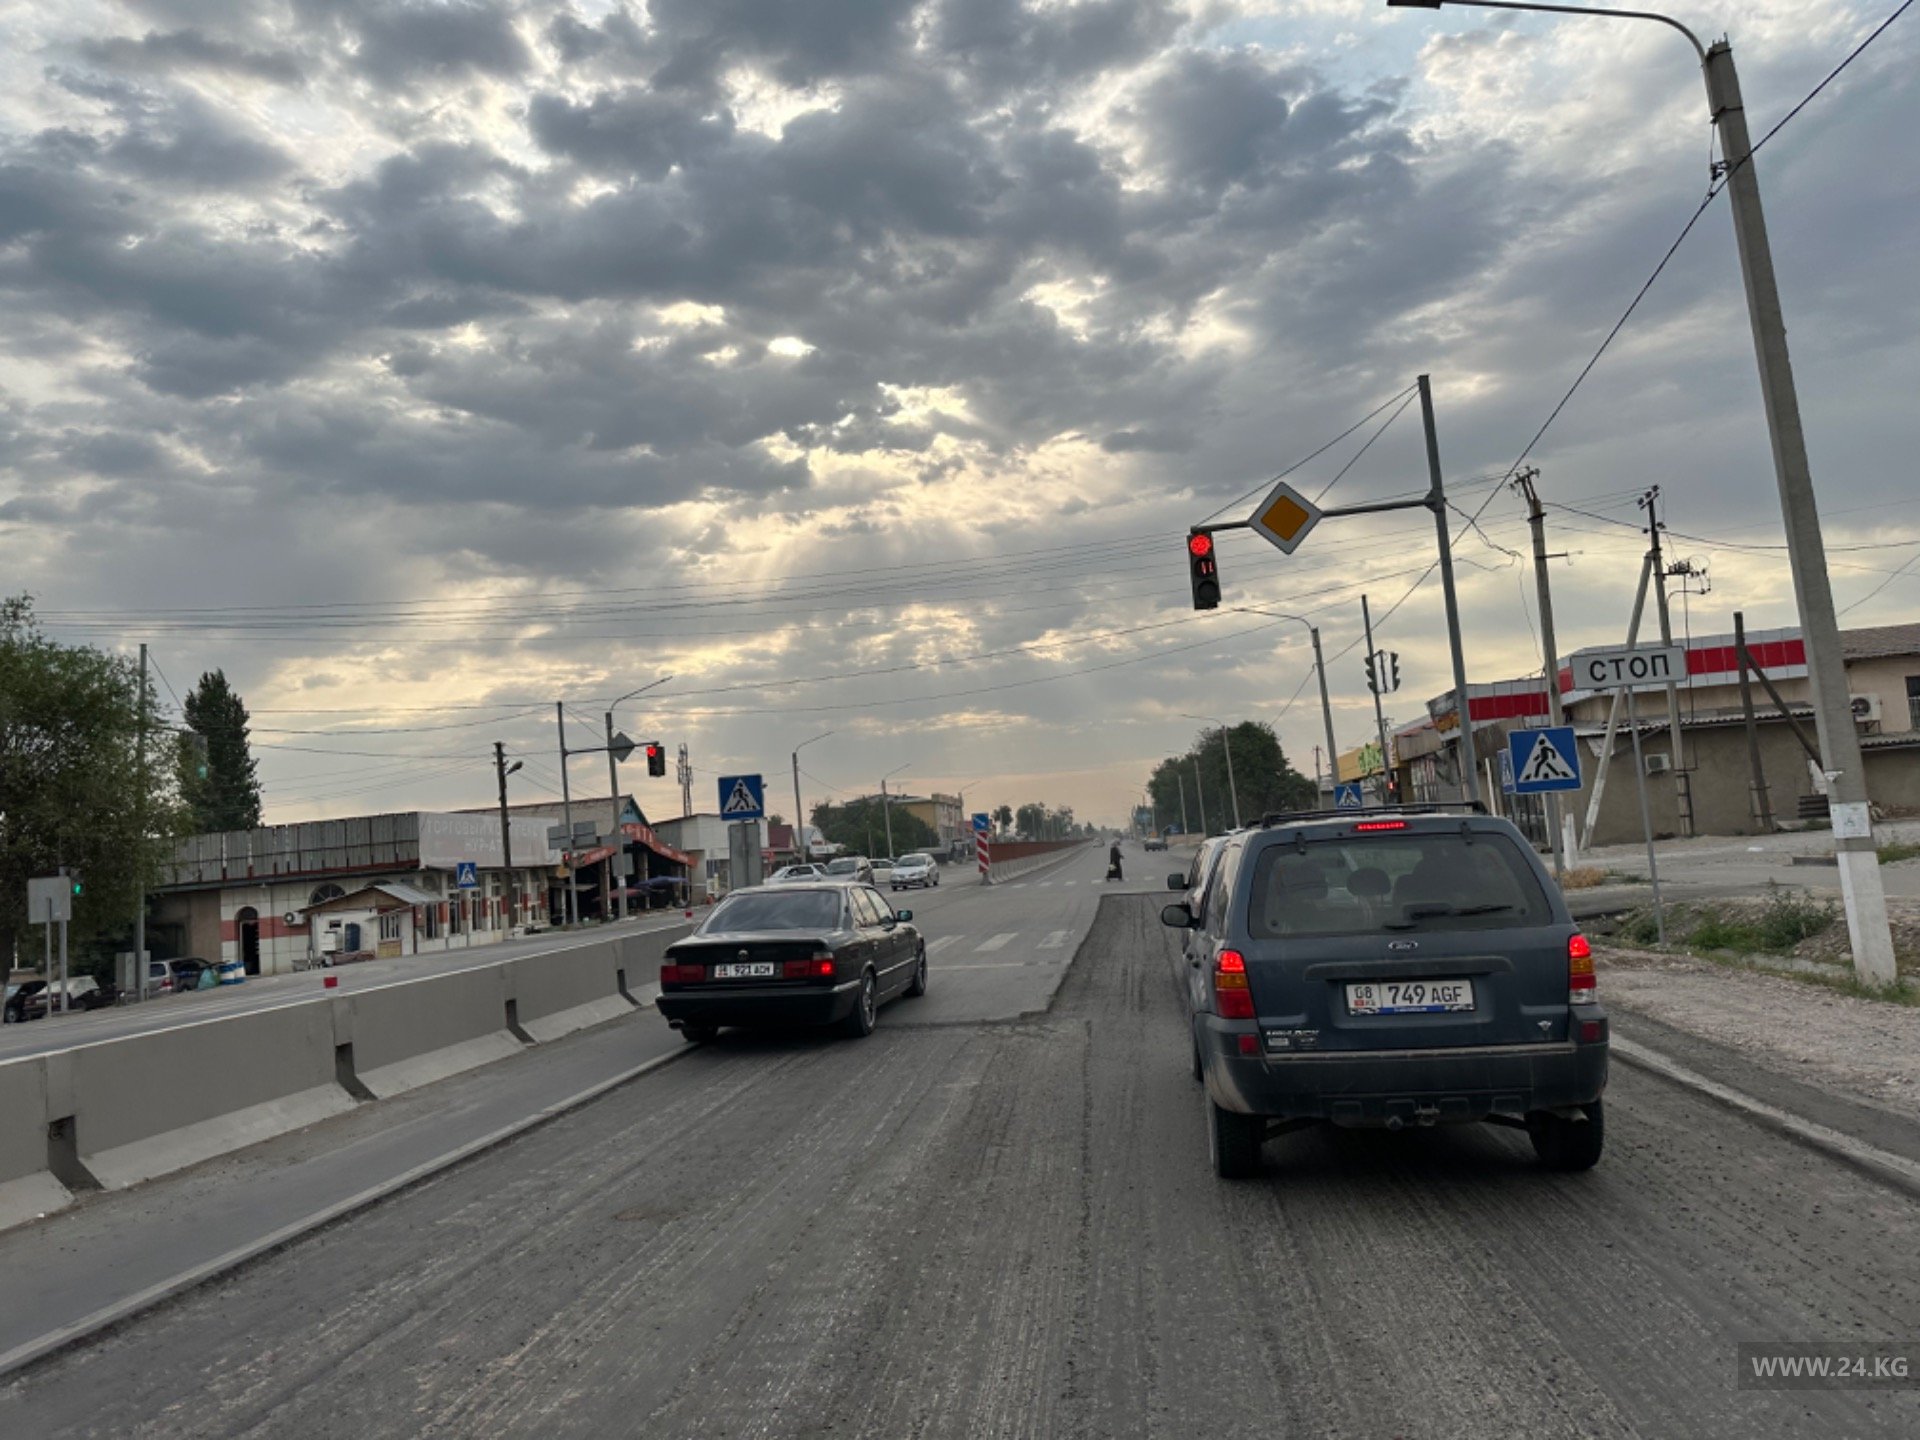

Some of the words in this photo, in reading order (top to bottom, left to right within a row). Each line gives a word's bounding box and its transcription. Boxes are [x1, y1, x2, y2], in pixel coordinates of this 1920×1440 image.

[1589, 654, 1670, 682] СТОП
[1388, 984, 1426, 1005] 749
[1431, 985, 1462, 1003] AGF
